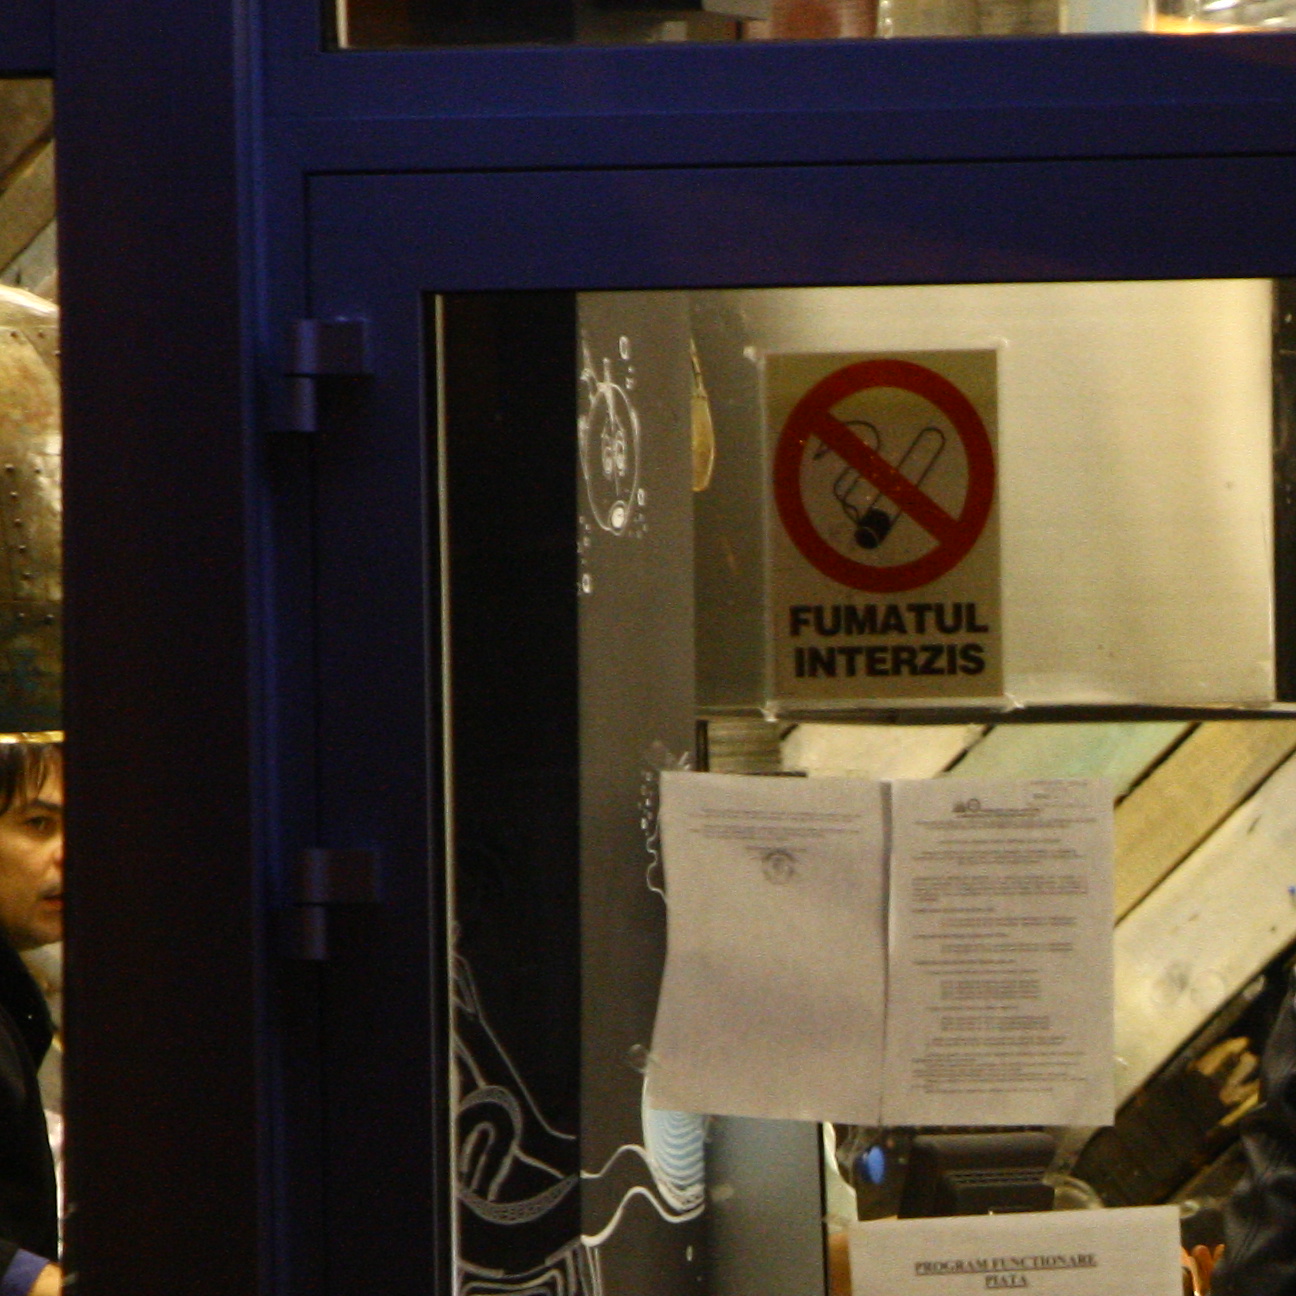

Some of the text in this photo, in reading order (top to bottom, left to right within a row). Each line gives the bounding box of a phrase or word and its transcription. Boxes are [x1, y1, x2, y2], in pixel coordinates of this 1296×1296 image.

[788, 602, 989, 636] FUMATUL
[794, 643, 986, 678] INTERZIS
[914, 1253, 1098, 1275] PROGRAM FUNCTIONARE
[984, 1274, 1028, 1289] PIATA
